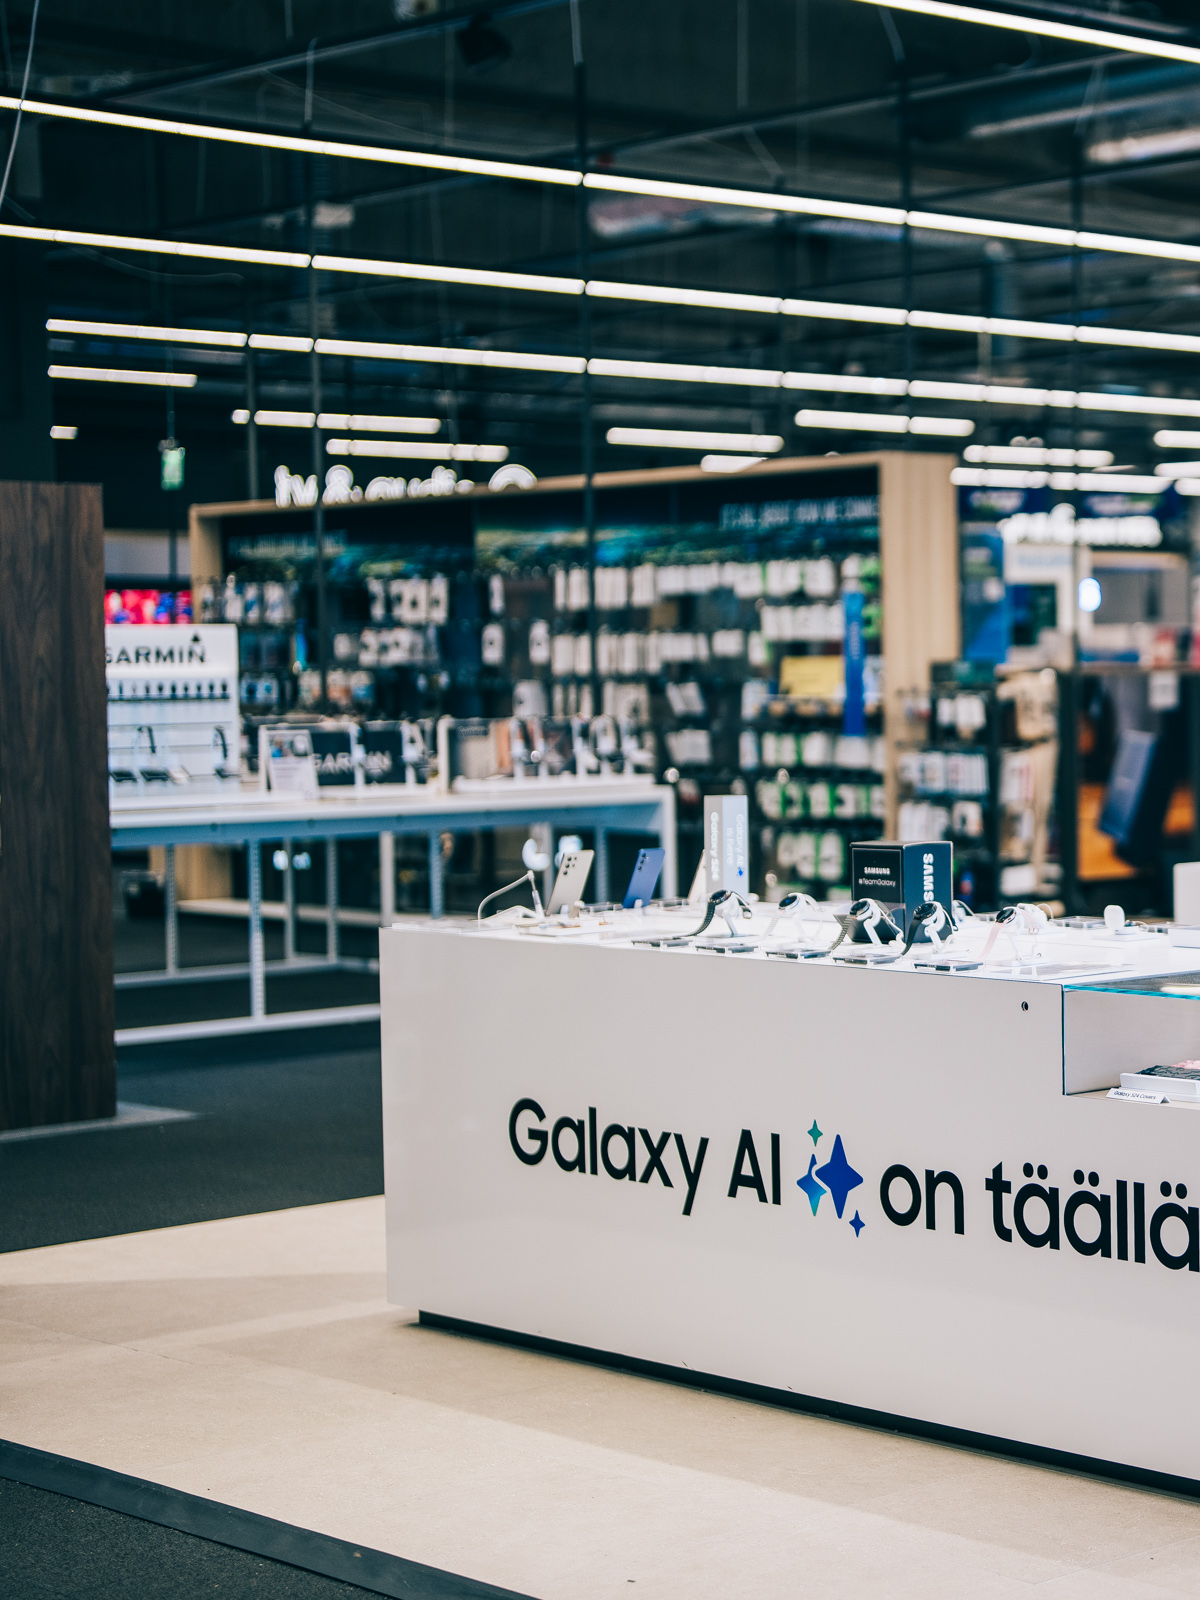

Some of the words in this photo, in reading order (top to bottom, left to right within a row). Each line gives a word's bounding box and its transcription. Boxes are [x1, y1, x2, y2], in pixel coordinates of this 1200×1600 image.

[863, 866, 891, 875] SAMSUNG
[923, 853, 934, 901] SAMS
[1113, 1090, 1130, 1098] Galaxy
[508, 1097, 709, 1217] Galaxy
[727, 1128, 781, 1206] AI
[880, 1163, 965, 1236] on
[985, 1160, 1200, 1273] täällä
